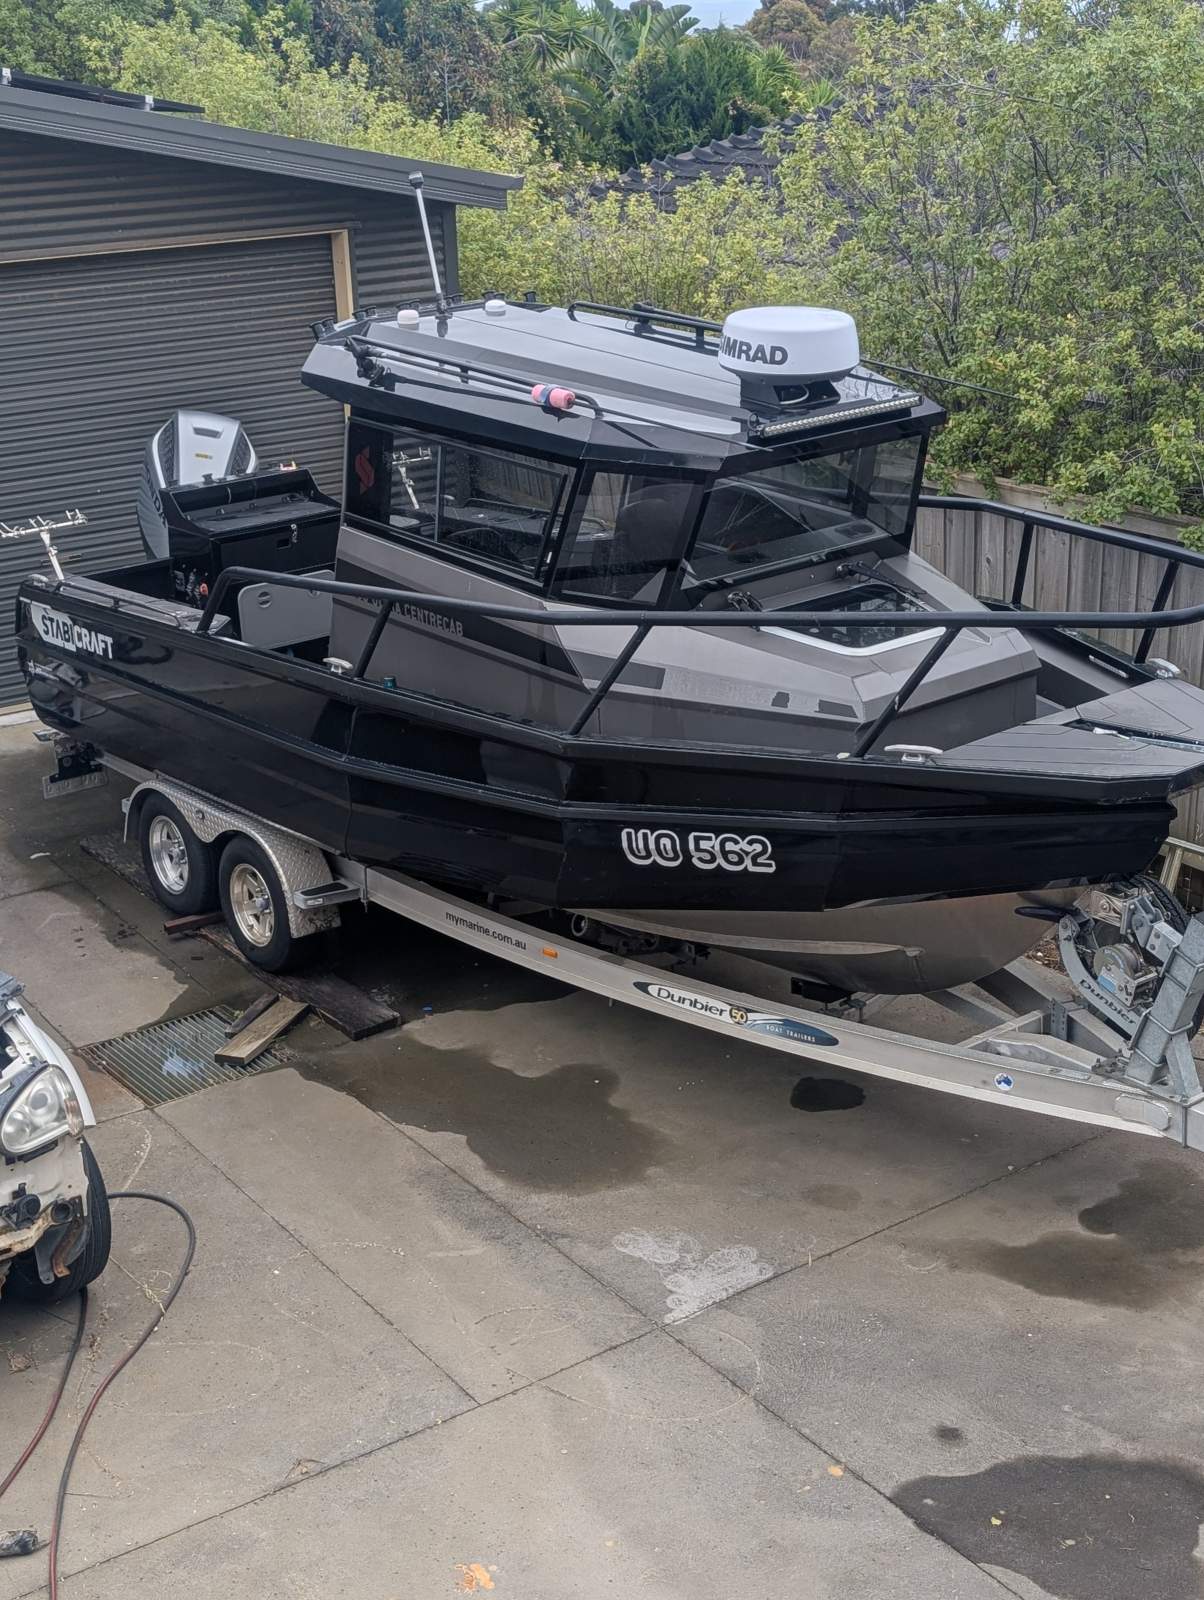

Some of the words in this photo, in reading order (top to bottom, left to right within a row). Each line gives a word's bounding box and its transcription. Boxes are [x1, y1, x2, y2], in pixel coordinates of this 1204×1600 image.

[41, 614, 113, 659] STABICRAFT
[403, 603, 464, 637] CENTRECAB
[688, 832, 776, 873] 562
[445, 912, 527, 950] mymarine.com.au
[657, 987, 728, 1017] Dunbier
[1080, 979, 1136, 1024] Dunbier
[766, 1024, 783, 1034] BOAT
[786, 1029, 816, 1042] TRAILERS
